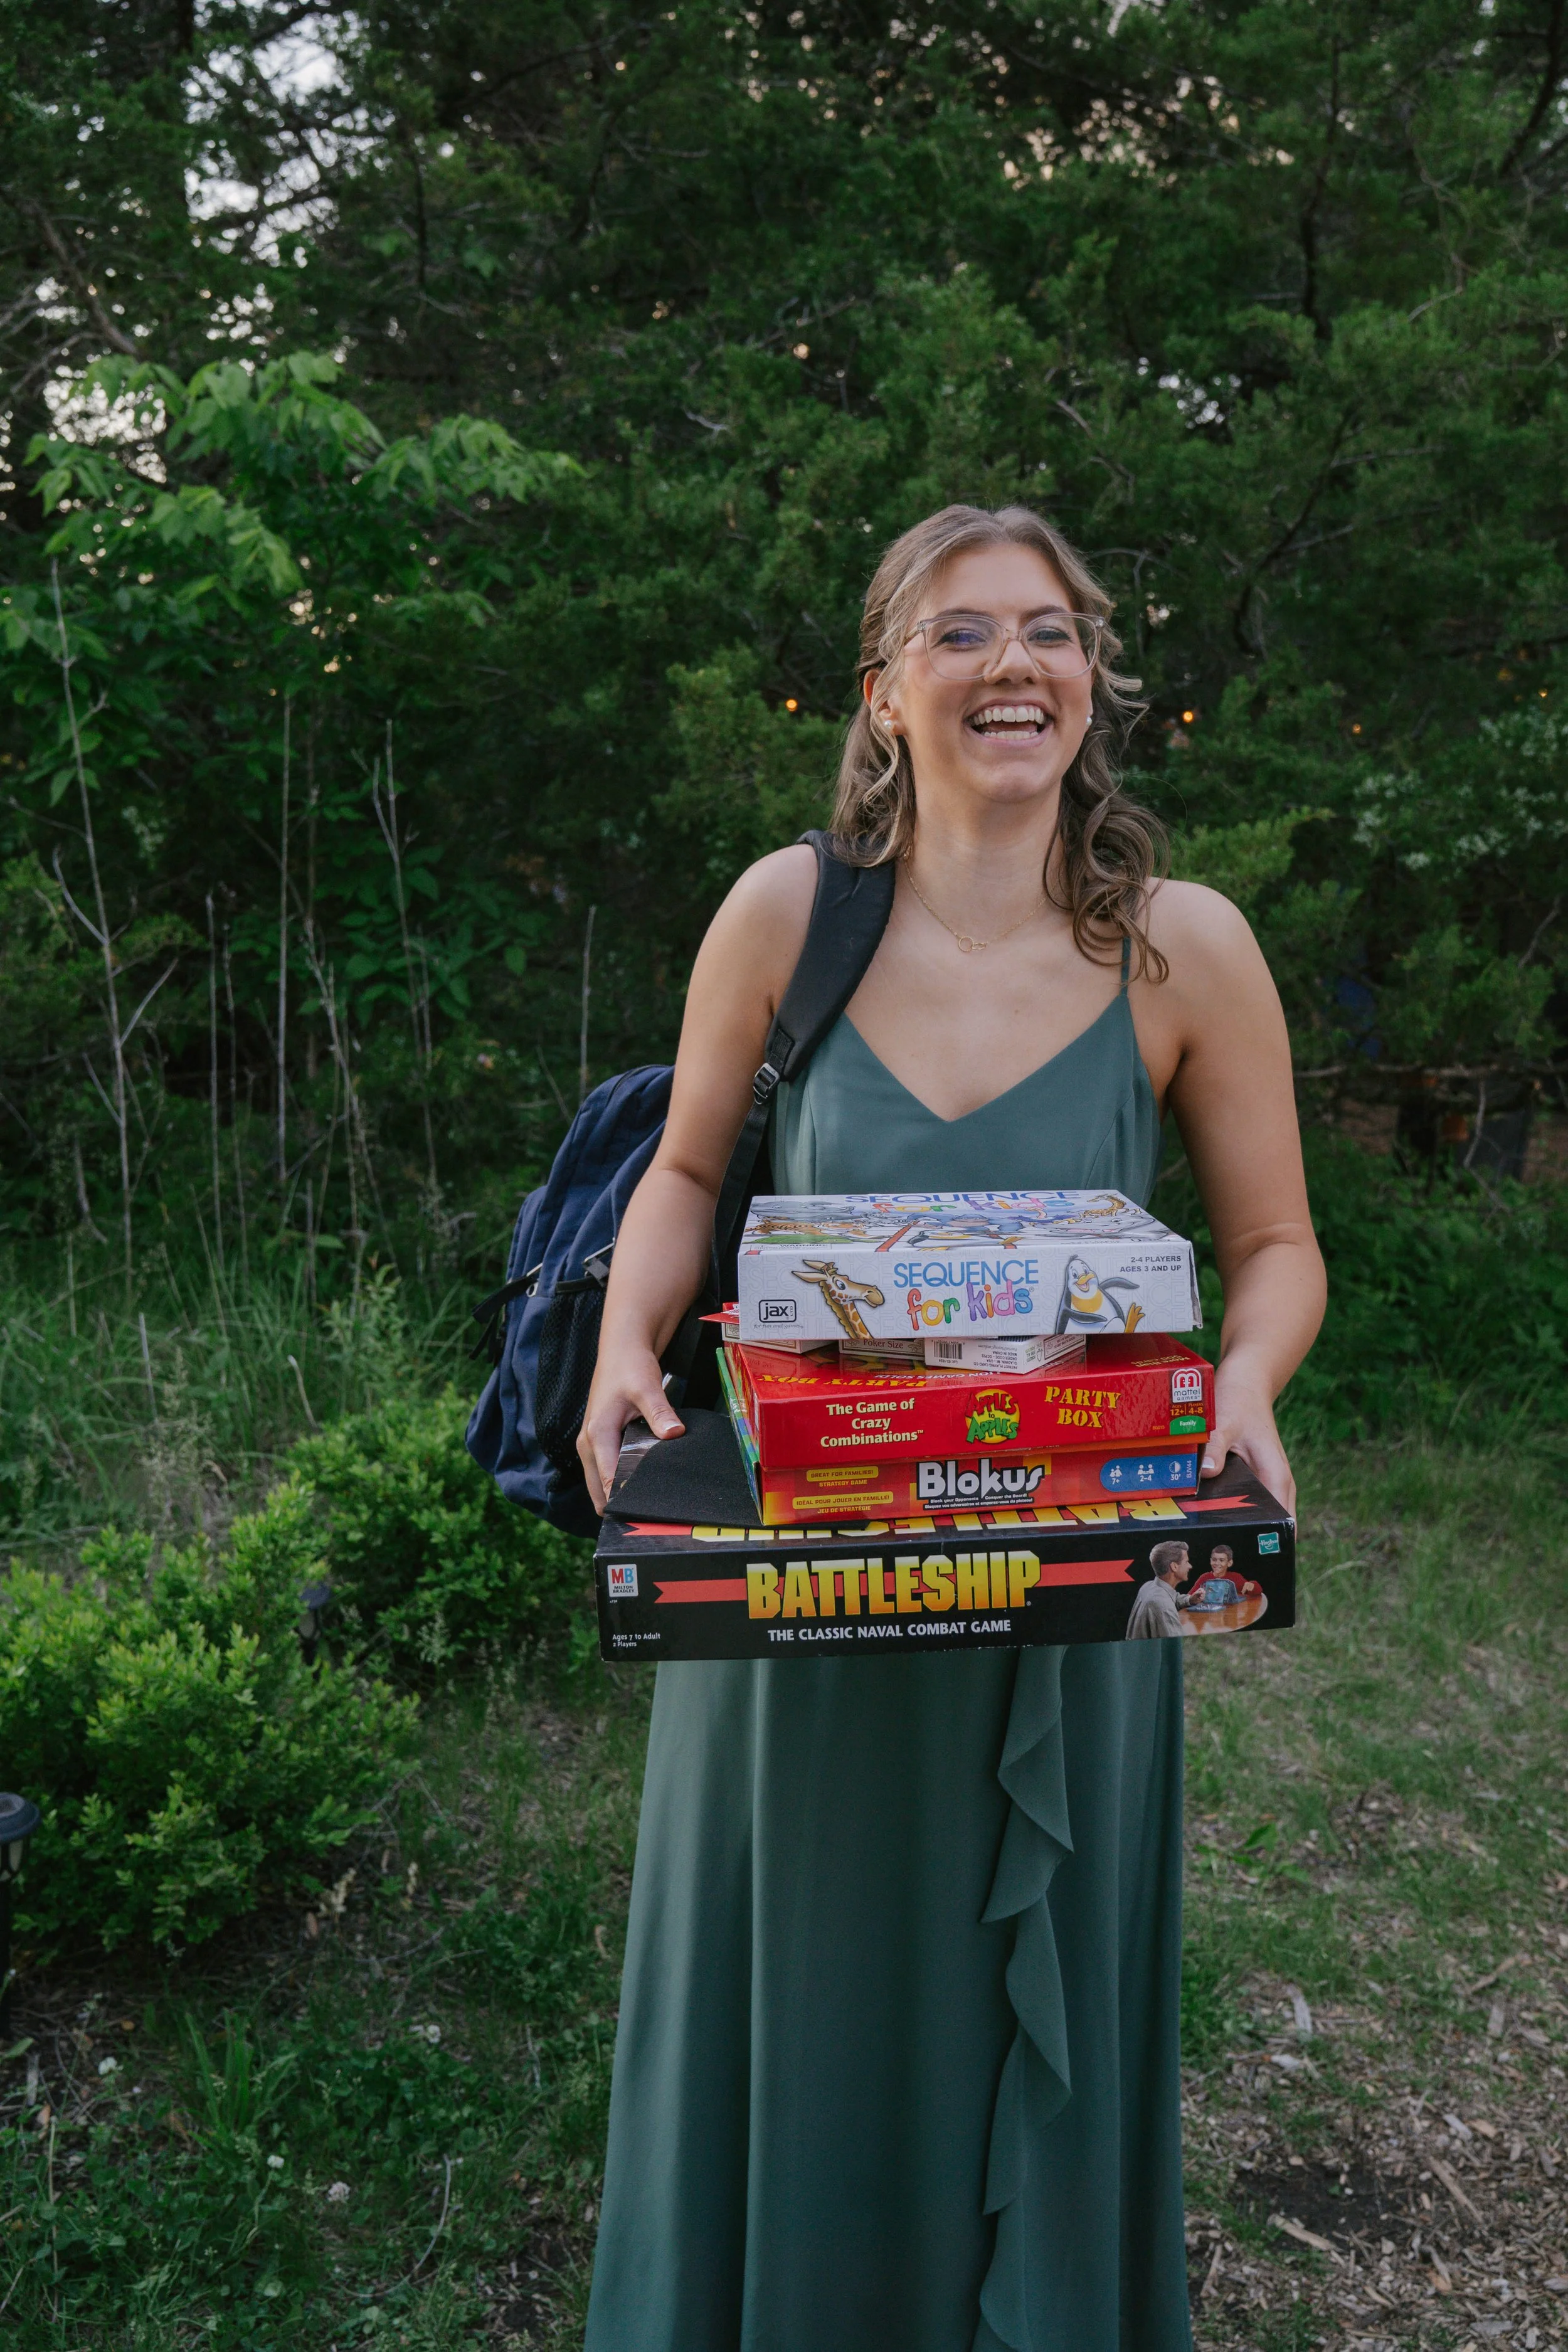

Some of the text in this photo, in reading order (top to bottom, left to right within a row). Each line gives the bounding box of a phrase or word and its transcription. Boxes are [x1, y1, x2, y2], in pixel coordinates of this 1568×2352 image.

[845, 1192, 1082, 1204] SEQUENCE
[872, 1197, 1075, 1212] for kids
[894, 1259, 1039, 1288] SEQUENCE
[763, 1303, 789, 1320] jax
[907, 1288, 960, 1330] for
[864, 1339, 885, 1347] Poker
[757, 1374, 926, 1387] PARTY BOX
[1044, 1386, 1121, 1409] PARTY
[1174, 1388, 1200, 1396] mattel
[826, 1397, 915, 1416] The Game of
[965, 1391, 1019, 1417] APPLES
[1189, 1406, 1204, 1414] 4-8
[852, 1417, 891, 1430] Crazy
[1056, 1408, 1103, 1428] BOX
[966, 1417, 1019, 1443] APPLES
[919, 1458, 1042, 1498] Blokus
[612, 1567, 634, 1584] MB
[768, 1619, 1011, 1641] THE CLASSIC NAVAL COMBAT GAME
